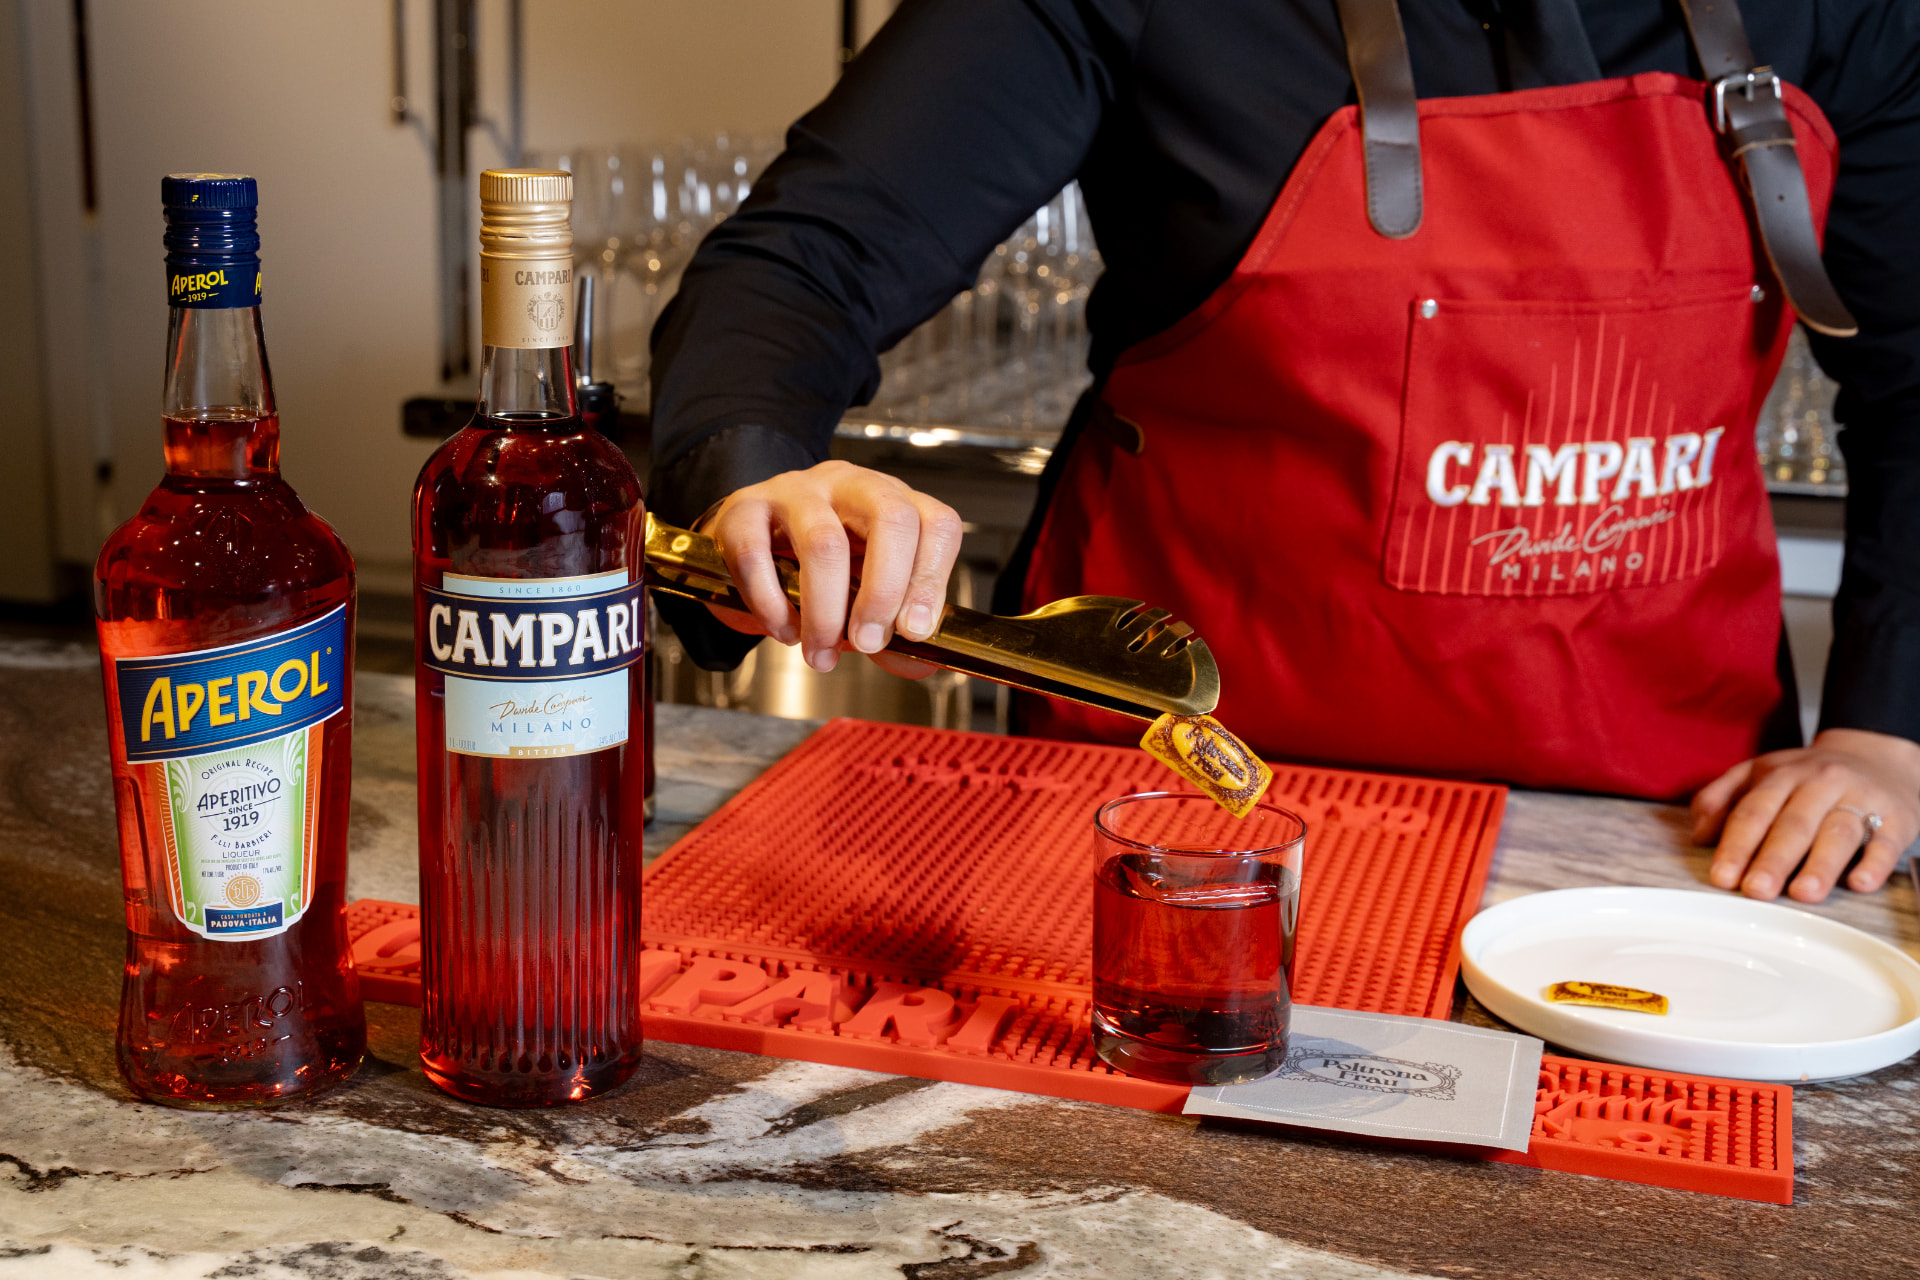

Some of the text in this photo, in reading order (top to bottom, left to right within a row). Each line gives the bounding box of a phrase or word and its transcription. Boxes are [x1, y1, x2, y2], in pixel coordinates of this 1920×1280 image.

[171, 269, 229, 296] APEROL
[514, 268, 571, 286] CAMPARI
[187, 292, 207, 303] 1919
[1426, 426, 1726, 507] CAMPARI
[1501, 551, 1644, 580] MILANO
[499, 584, 582, 595] SINCE 1860
[428, 597, 641, 668] CAMPARI
[140, 649, 330, 743] APEROL
[490, 717, 592, 734] MILANO
[517, 746, 567, 756] BITTER
[200, 758, 274, 780] ORIGINAL RECIPE
[196, 777, 281, 812] APERITIVO
[228, 802, 253, 815] SINCE
[223, 810, 260, 832] 1919
[222, 849, 261, 859] LIQUEUR
[1321, 1057, 1429, 1082] Poltrona
[1338, 1069, 1399, 1088] Frau
